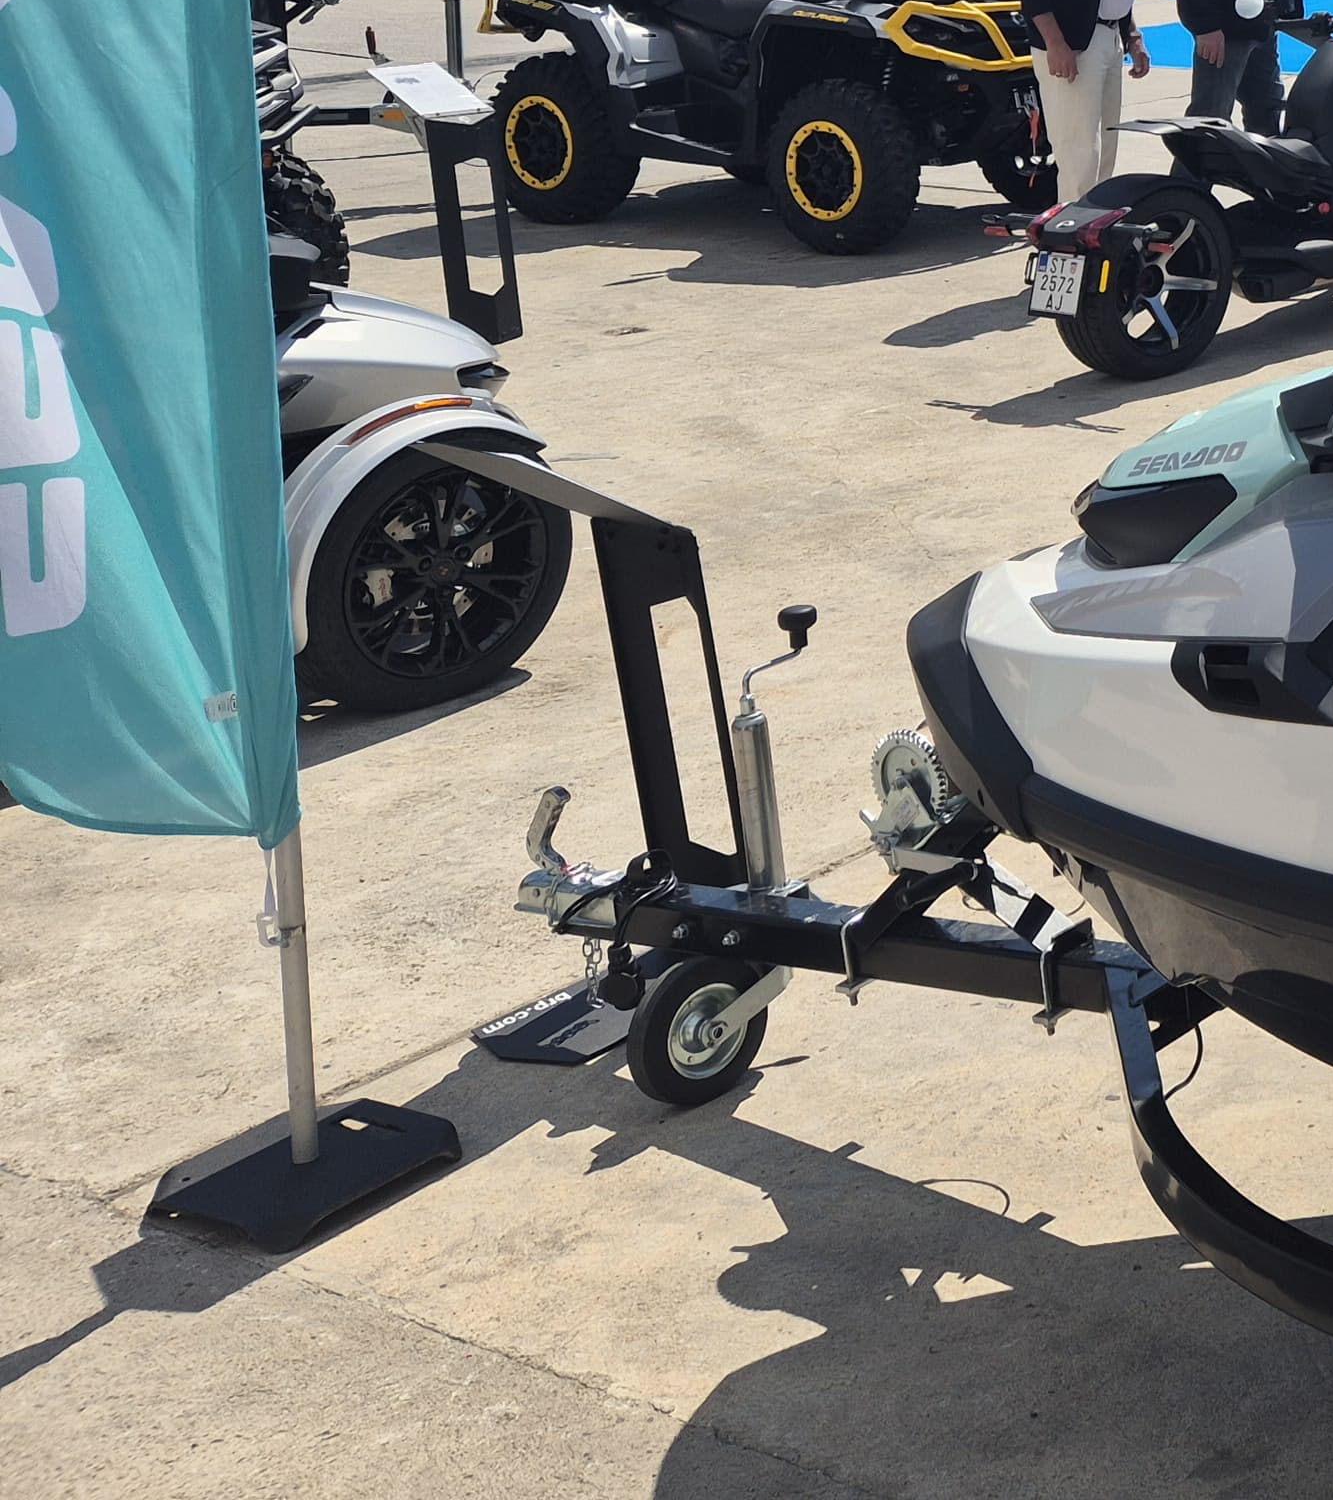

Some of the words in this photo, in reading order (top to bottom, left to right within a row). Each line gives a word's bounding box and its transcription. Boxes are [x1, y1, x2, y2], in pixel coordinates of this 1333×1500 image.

[1049, 257, 1067, 274] ST
[1040, 274, 1075, 294] 2572
[1045, 293, 1064, 311] AJ
[481, 991, 573, 1035] brp.com
